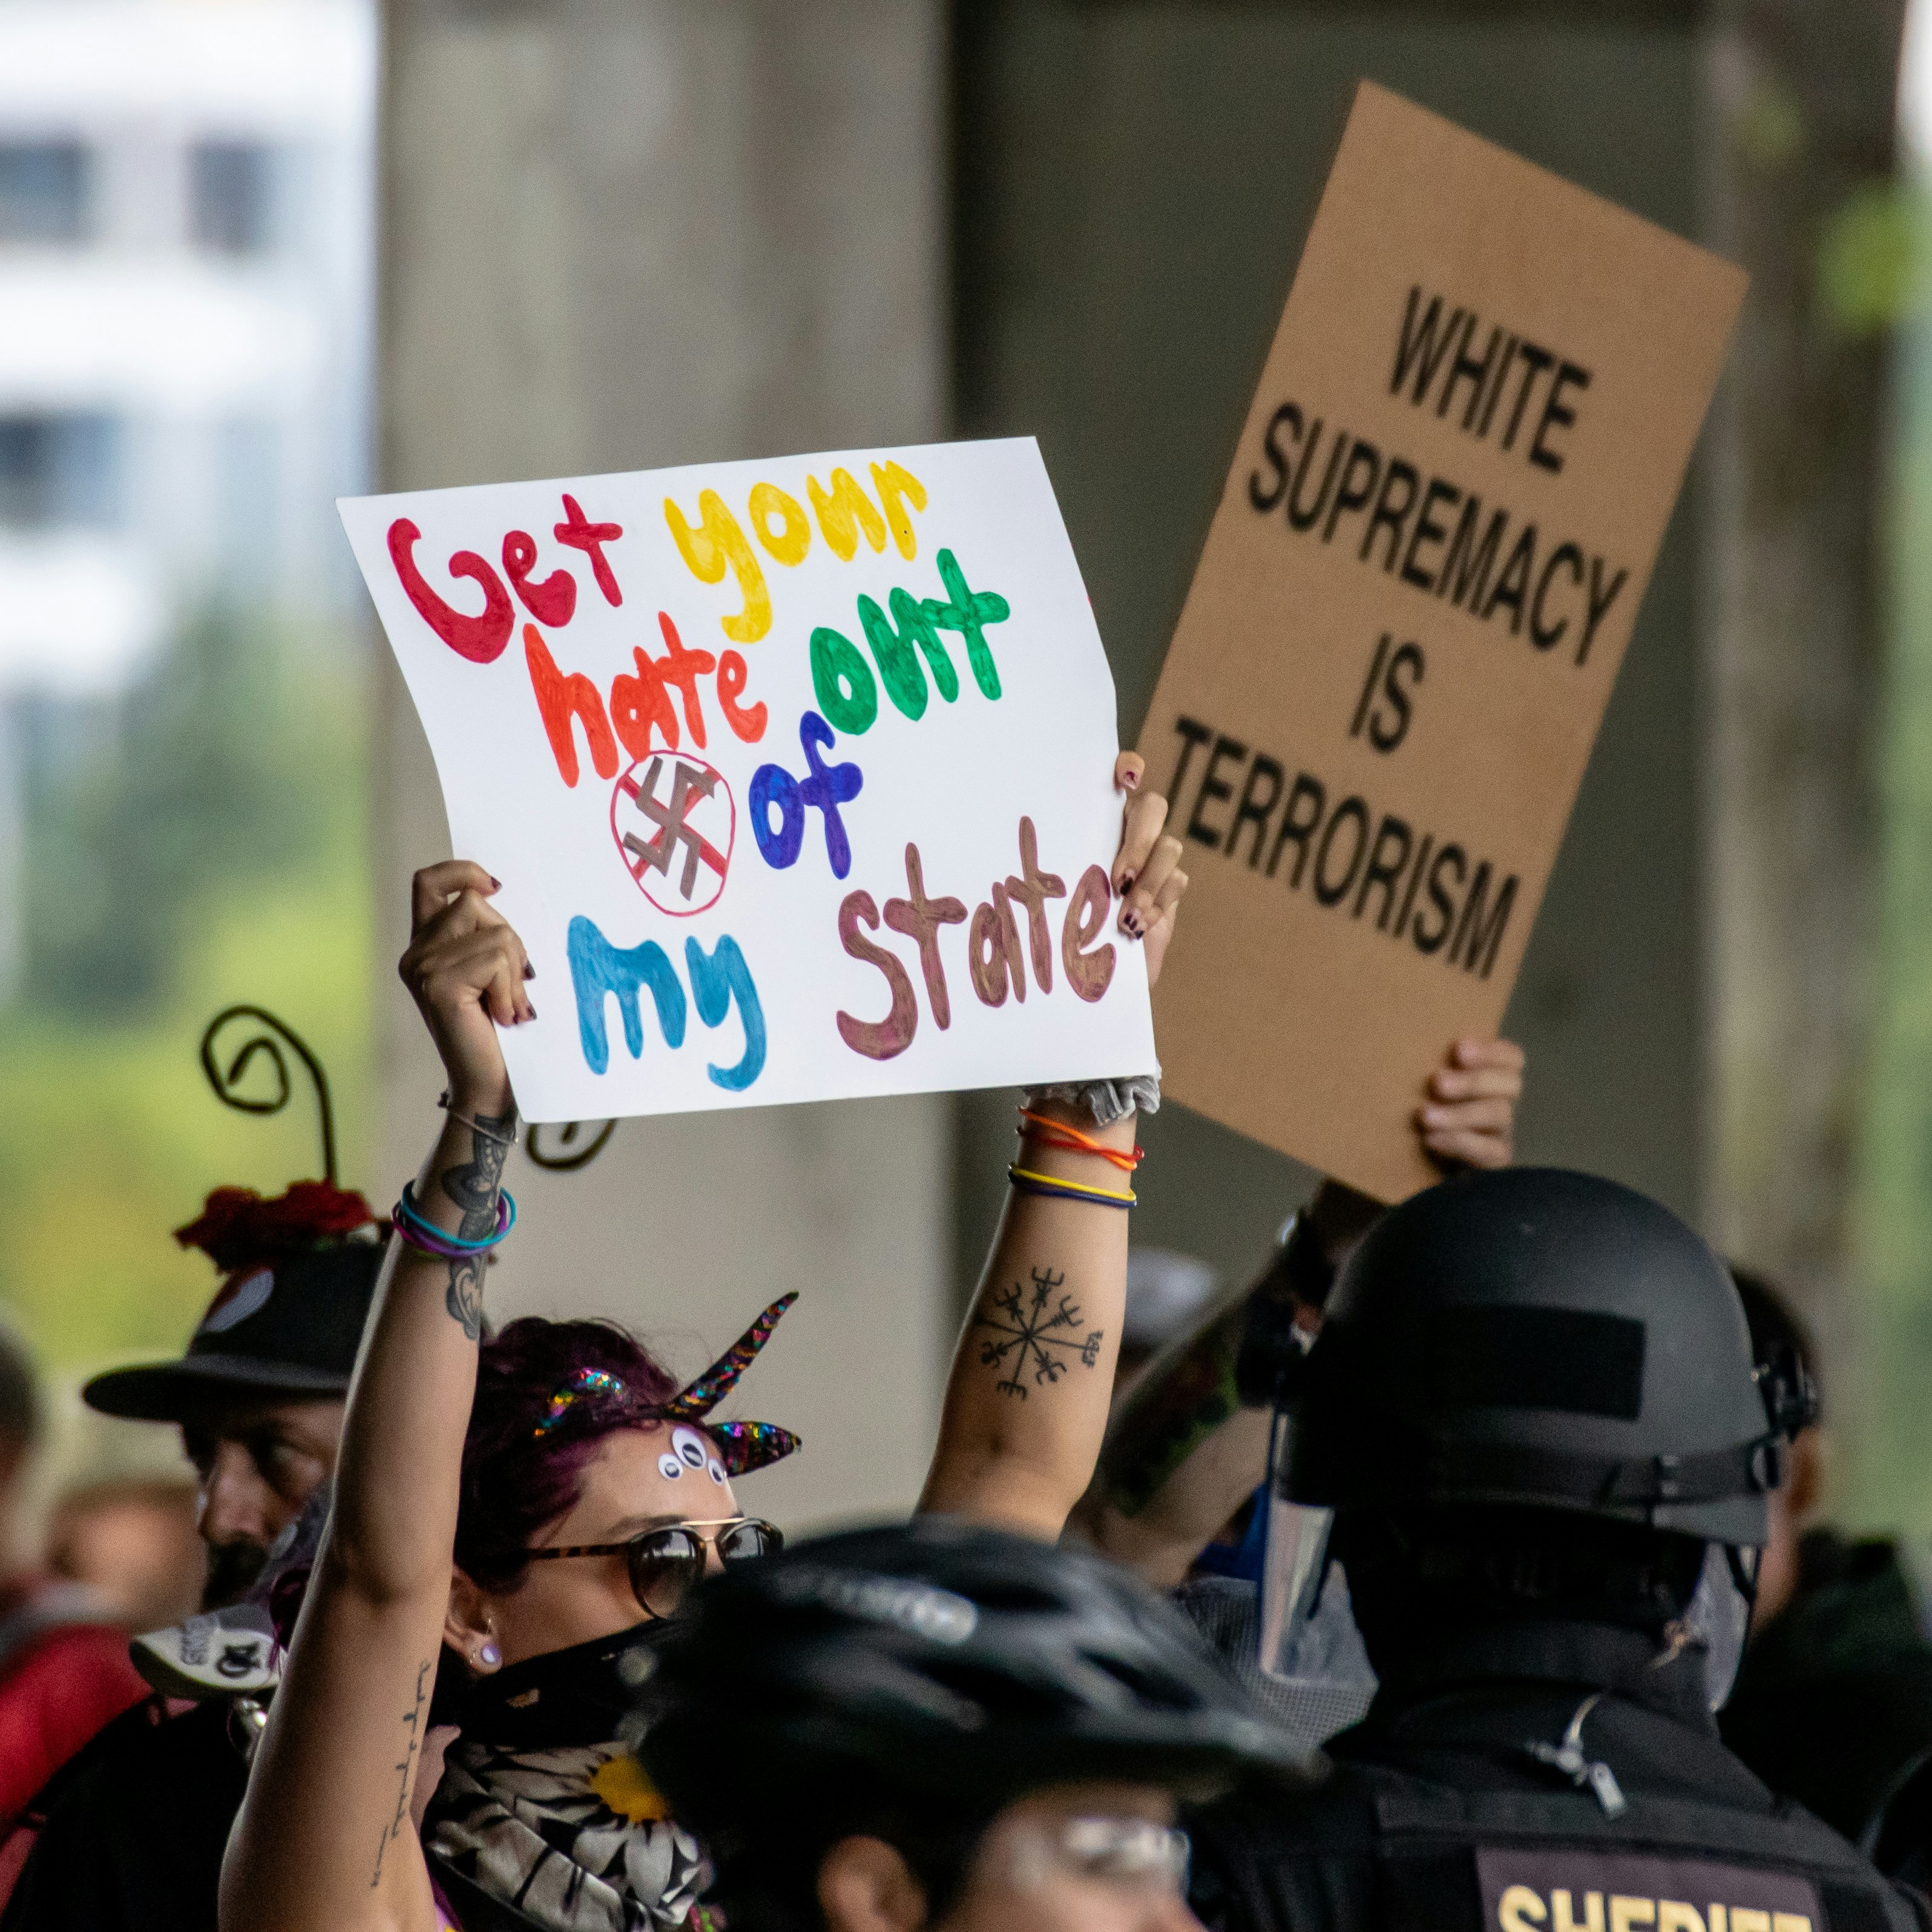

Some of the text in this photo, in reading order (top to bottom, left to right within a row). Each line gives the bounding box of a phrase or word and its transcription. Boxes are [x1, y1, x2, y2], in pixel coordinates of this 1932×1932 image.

[1389, 284, 1593, 475] WHITE
[386, 460, 928, 665] Get your
[1247, 401, 1629, 668] SUPREMACY
[523, 548, 1011, 788] hate out
[1349, 632, 1425, 755] IS
[748, 710, 863, 881] of
[1163, 714, 1521, 981] TERRORISM
[567, 815, 1117, 1092] my state
